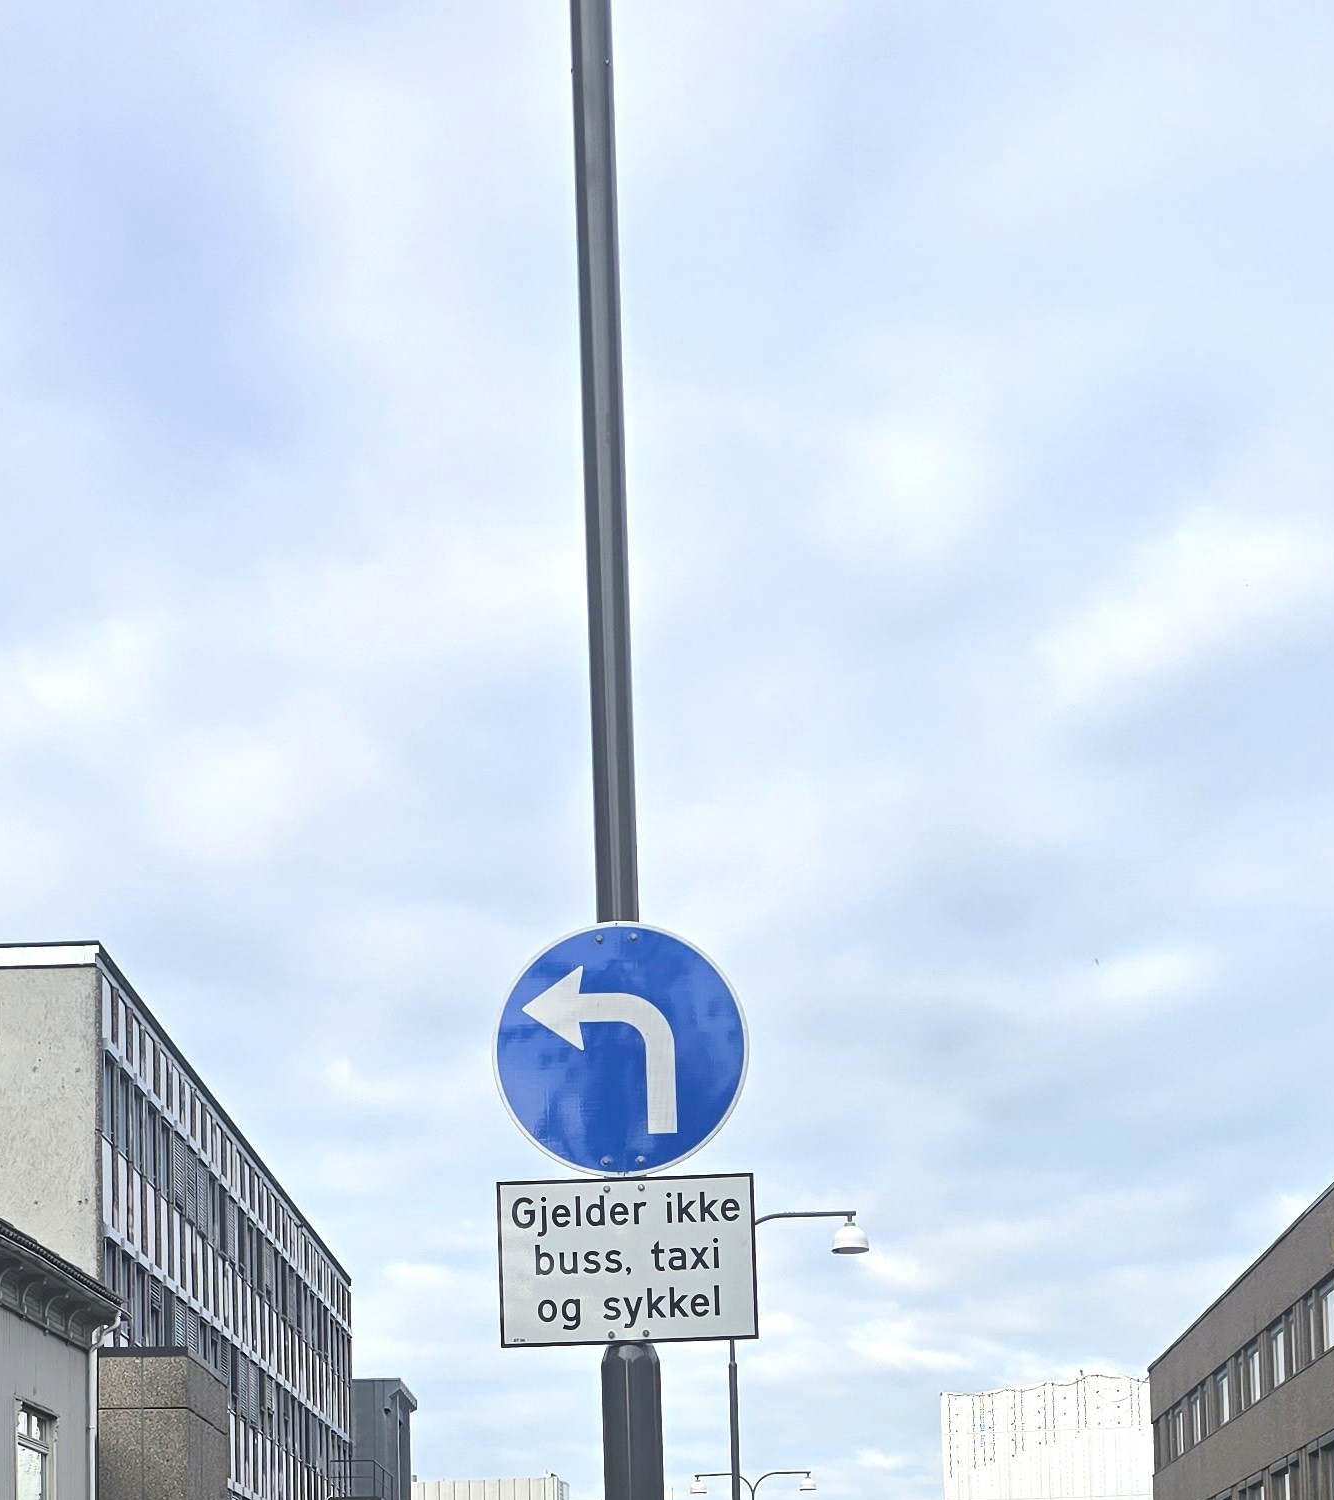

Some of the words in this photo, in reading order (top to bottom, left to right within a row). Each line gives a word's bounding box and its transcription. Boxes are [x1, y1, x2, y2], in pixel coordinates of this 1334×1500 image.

[511, 1195, 647, 1237] Gjelder
[666, 1191, 741, 1224] ikke
[534, 1244, 632, 1276] buss,
[651, 1237, 720, 1271] taxi
[537, 1298, 581, 1331] og
[603, 1284, 721, 1329] sykkel
